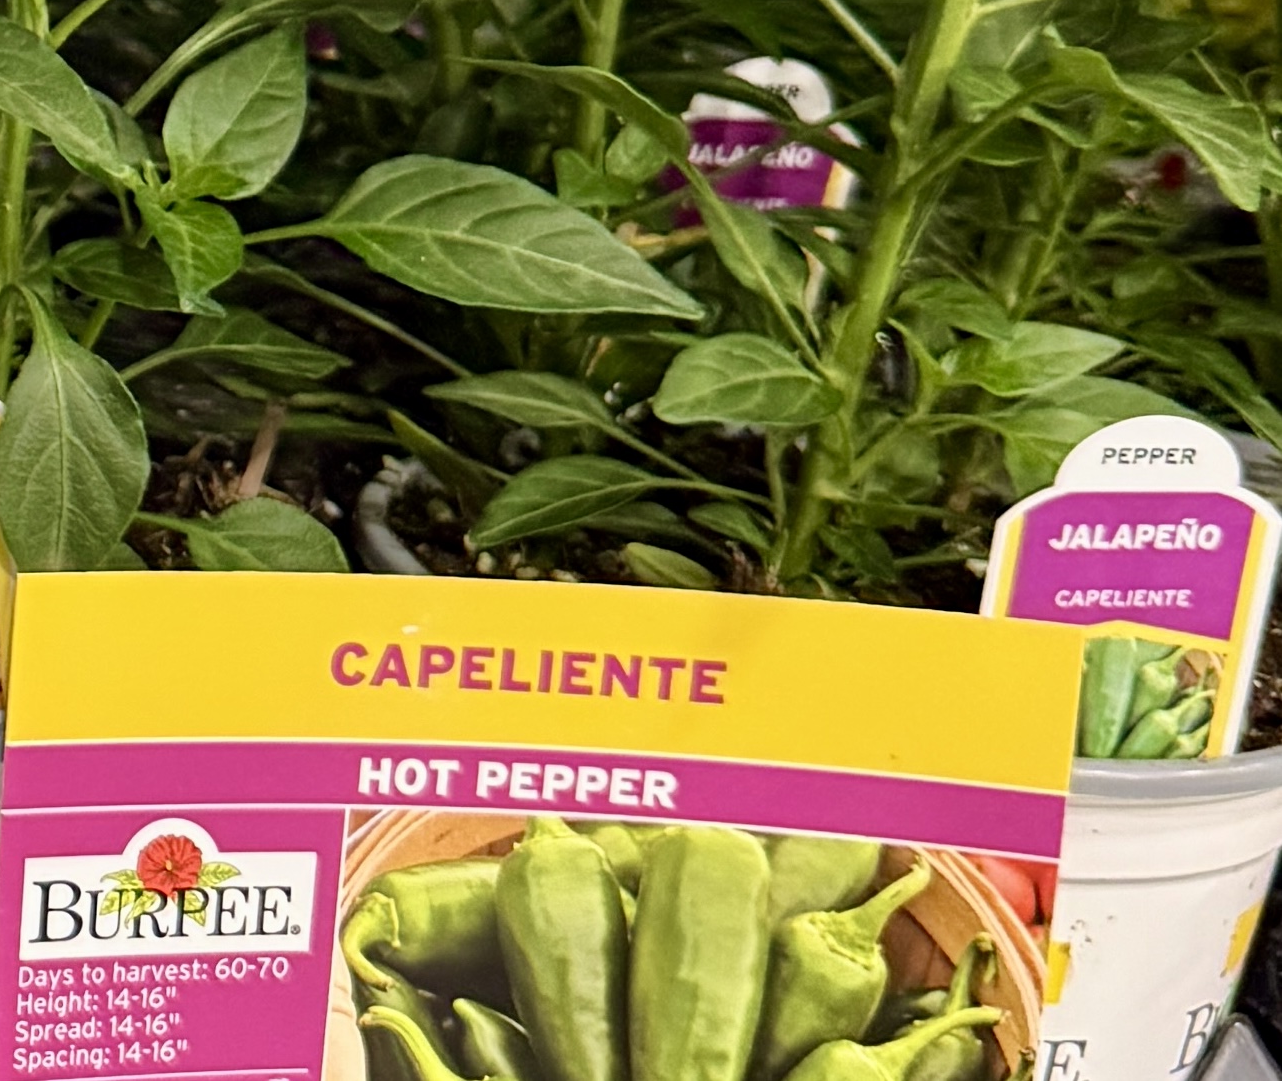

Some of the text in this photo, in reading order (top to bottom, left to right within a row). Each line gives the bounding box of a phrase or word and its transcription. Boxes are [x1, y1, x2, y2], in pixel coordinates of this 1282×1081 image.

[1101, 447, 1198, 465] PEPPER
[1047, 517, 1223, 552] JALAPEÑO
[1053, 588, 1194, 609] CAPELIENTE
[329, 641, 729, 706] CAPELIENTE
[357, 756, 679, 811] HOT PEPPER
[17, 956, 290, 990] Days to harvest: 60-70
[16, 985, 177, 1017] Height: 14-16"
[14, 1012, 181, 1046] Spread: 14-16"
[12, 1038, 189, 1073] Spacing: 14-16"
